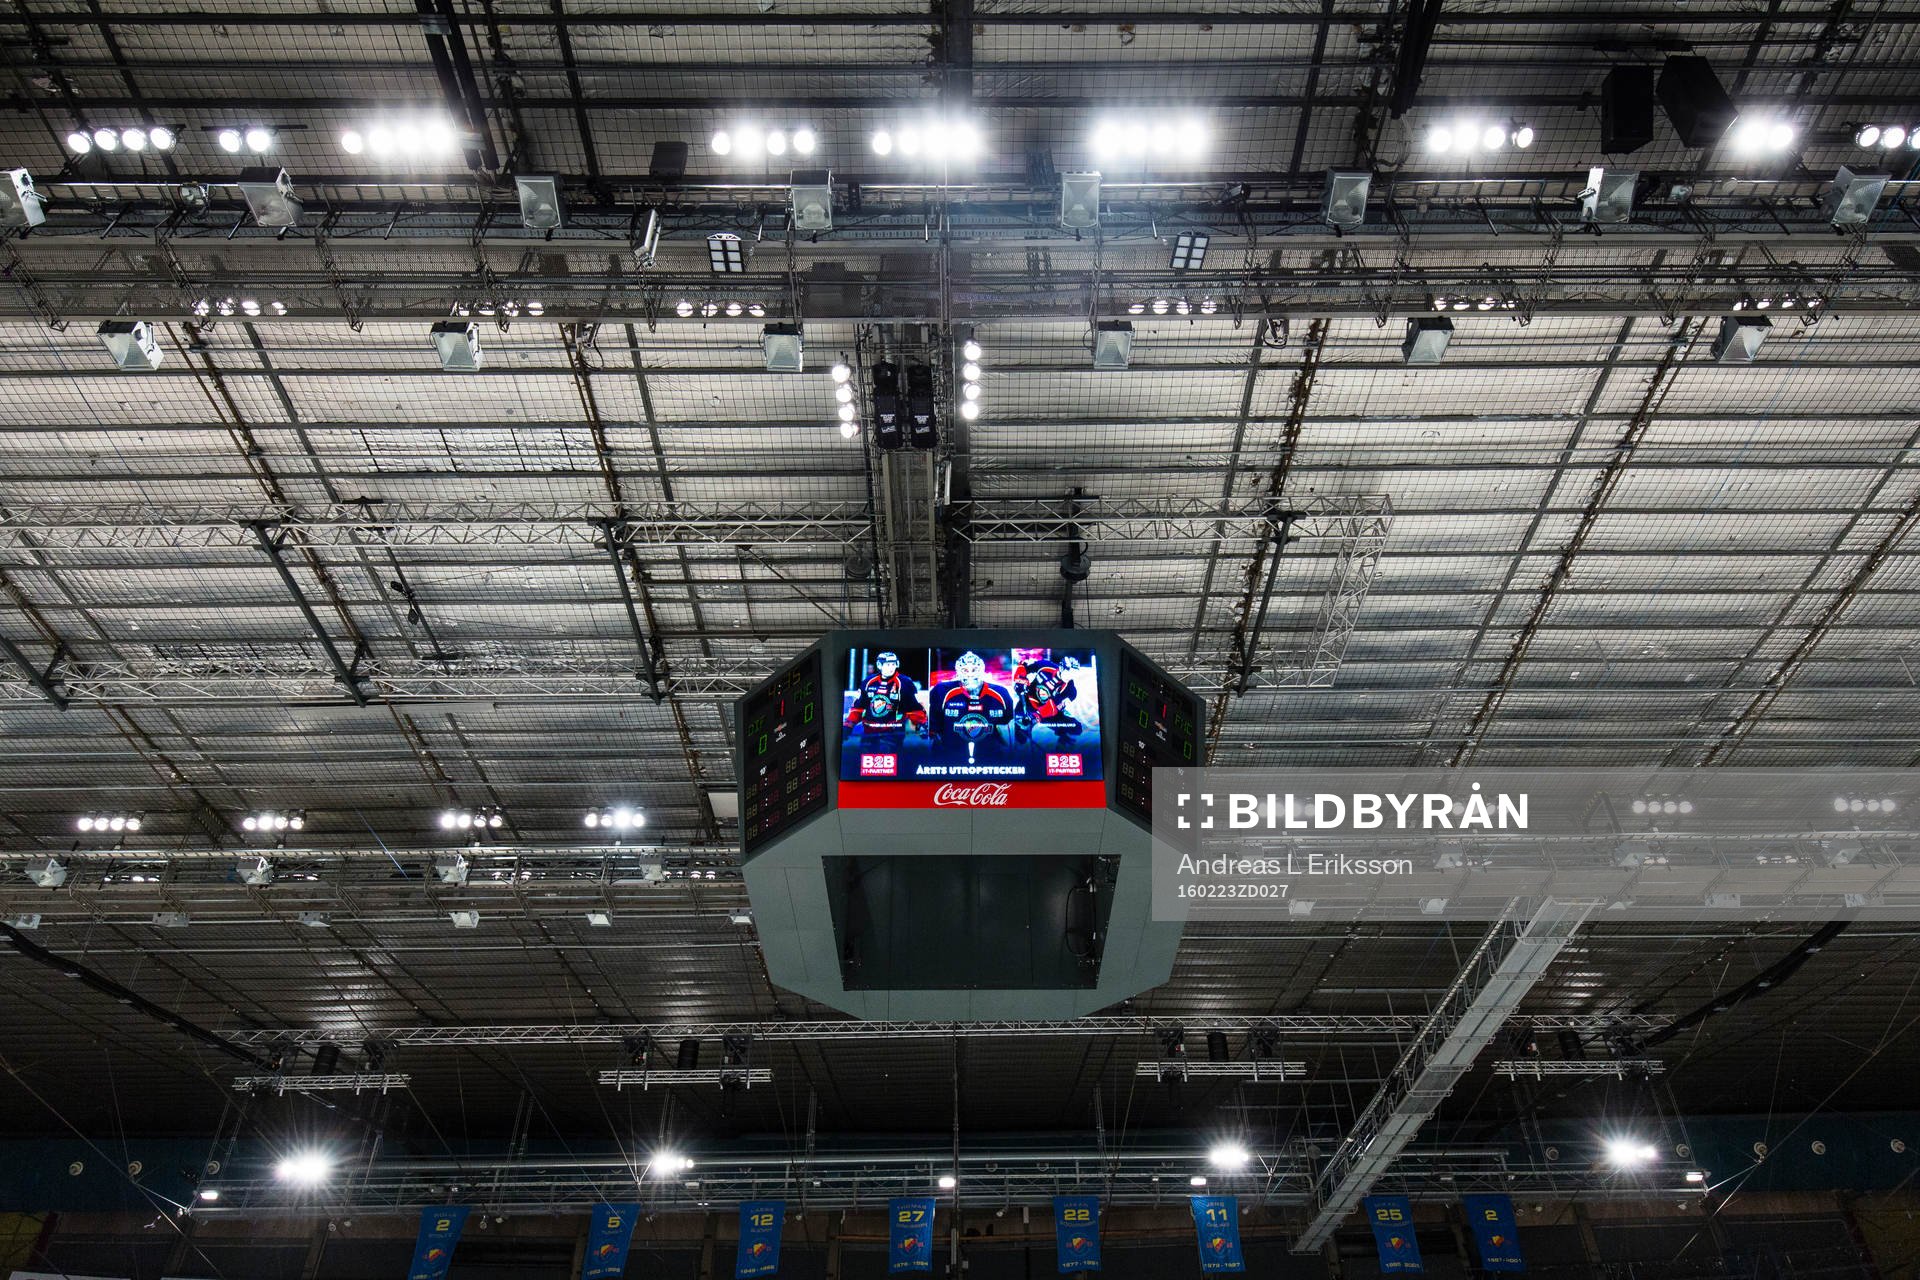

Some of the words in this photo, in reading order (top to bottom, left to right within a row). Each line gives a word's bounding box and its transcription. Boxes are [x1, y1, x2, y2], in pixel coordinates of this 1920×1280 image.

[862, 755, 895, 768] B2B
[1048, 755, 1080, 768] B2B
[916, 765, 947, 775] ÅRETS
[949, 766, 1025, 775] UTROPSTECKEN
[933, 783, 1012, 806] Coca-Cola
[750, 1214, 774, 1226] 12
[898, 1210, 925, 1222] 27
[1064, 1209, 1090, 1221] 22
[1206, 1208, 1228, 1221] 11
[1376, 1209, 1403, 1220] 25
[1485, 1209, 1499, 1221] 2
[436, 1219, 451, 1231] 2
[607, 1216, 621, 1228] 5
